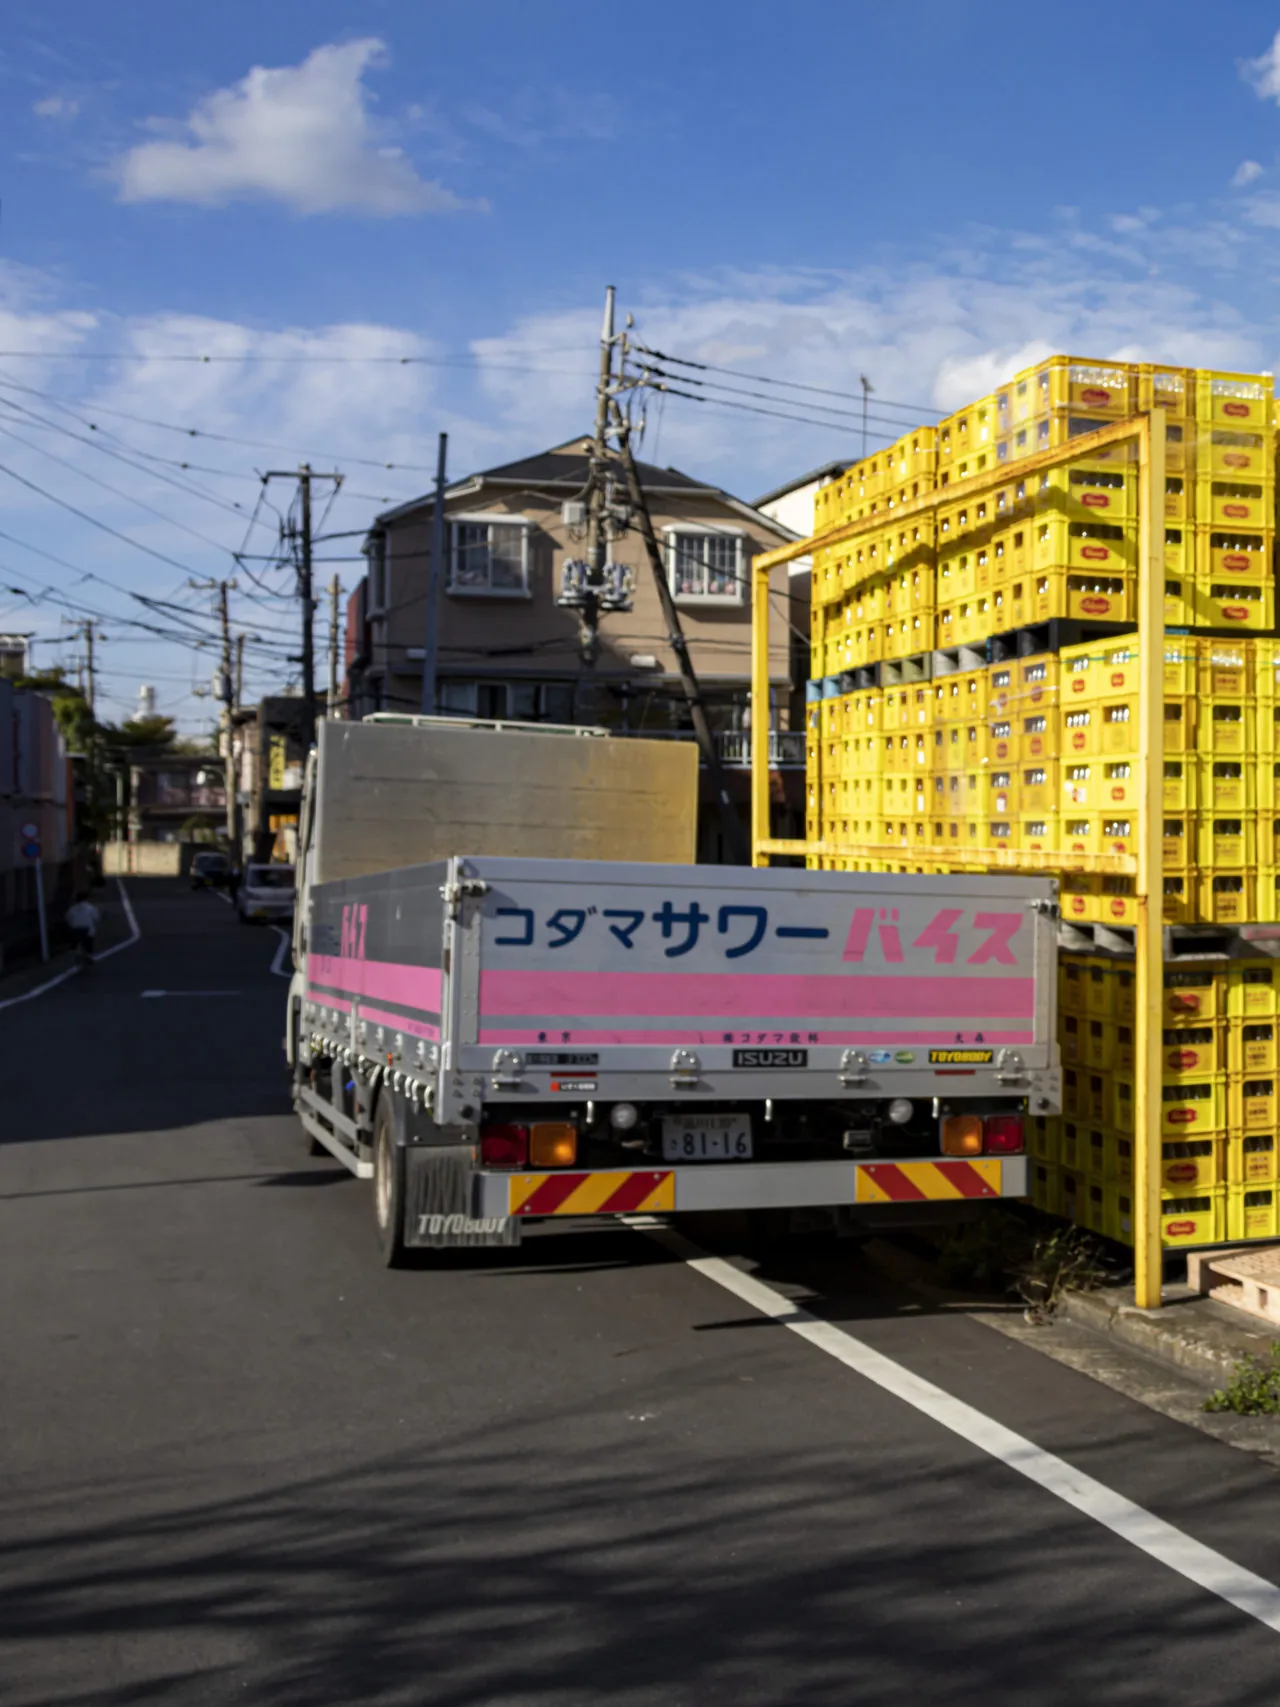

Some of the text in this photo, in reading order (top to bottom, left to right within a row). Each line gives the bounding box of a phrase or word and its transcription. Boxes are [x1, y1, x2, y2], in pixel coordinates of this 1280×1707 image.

[494, 901, 830, 959] コダマサワー
[841, 907, 1024, 965] バイス
[737, 1051, 803, 1066] ISUZU
